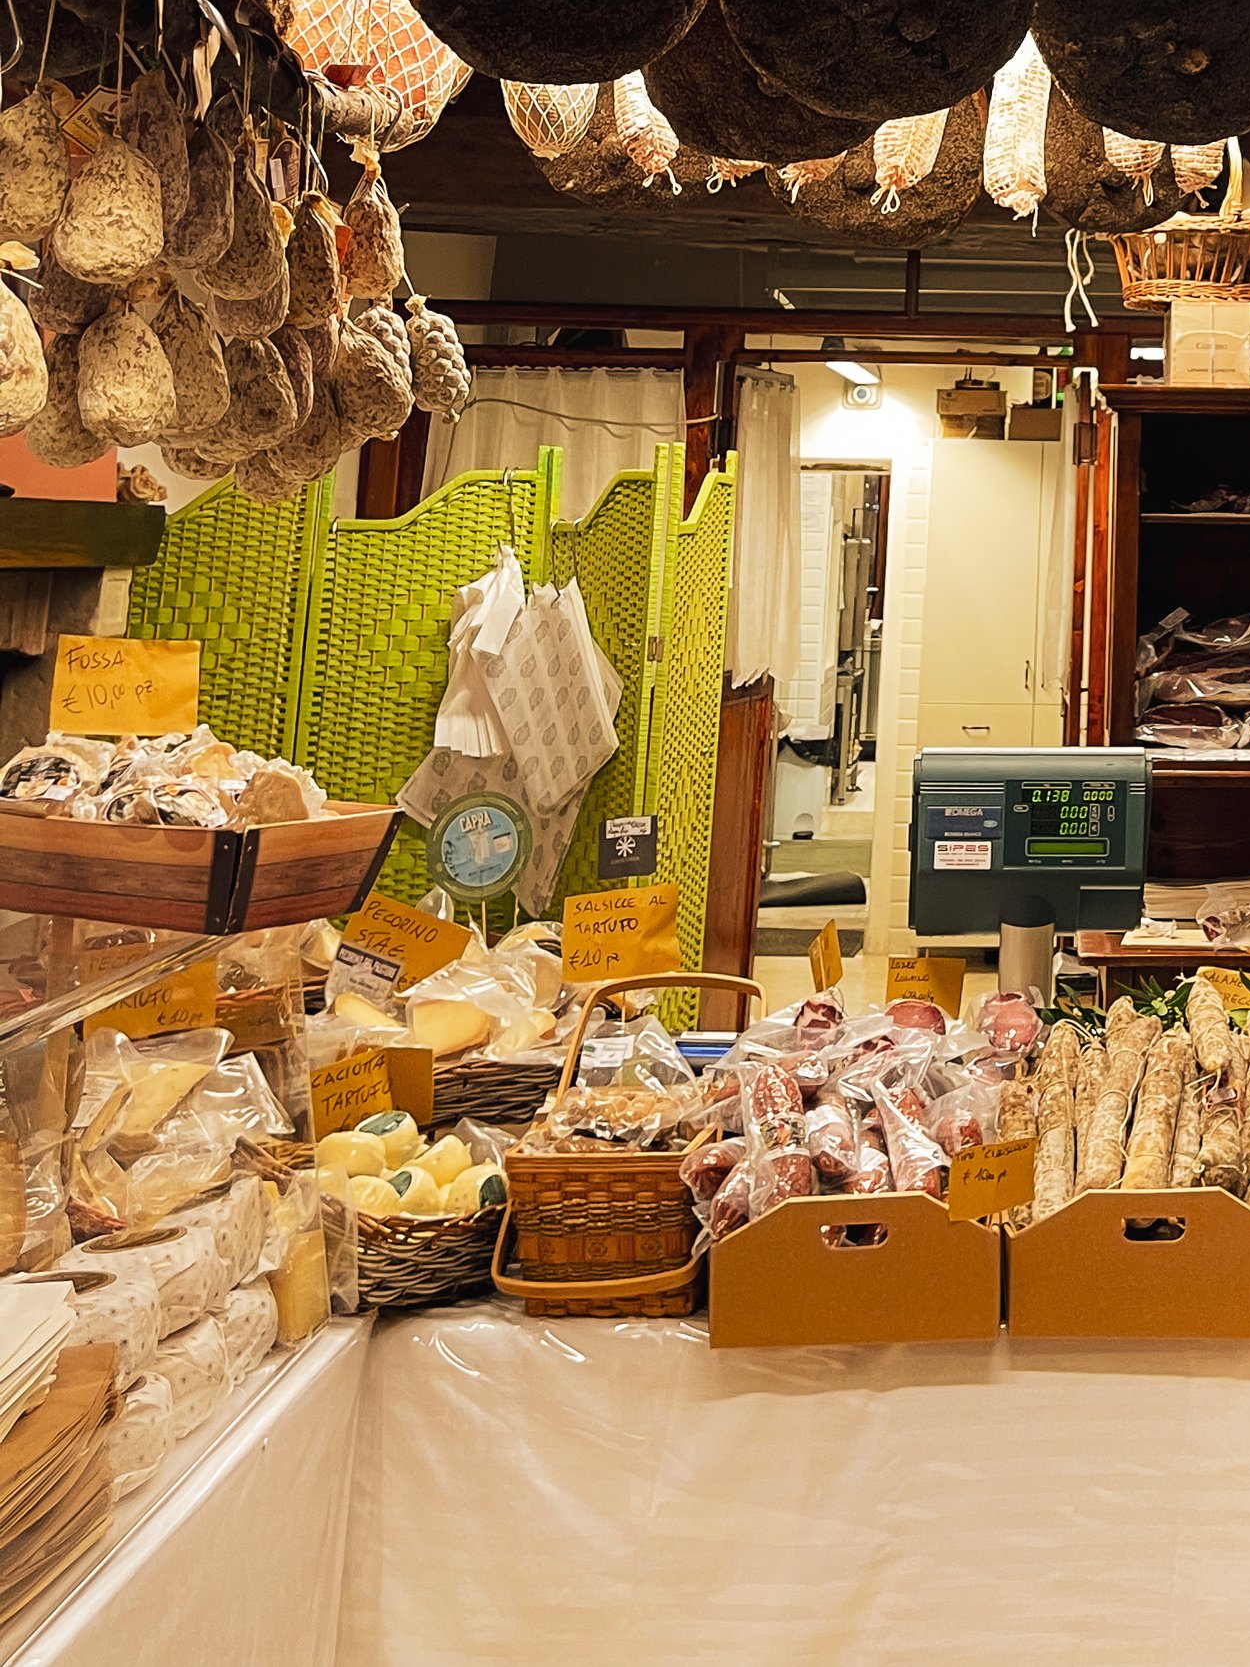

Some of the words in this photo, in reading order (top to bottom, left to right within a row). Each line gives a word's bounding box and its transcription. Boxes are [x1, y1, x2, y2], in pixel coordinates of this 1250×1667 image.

[66, 644, 125, 673] FOSSA
[459, 810, 494, 834] CAPRA
[649, 895, 668, 907] AL
[364, 900, 440, 943] PECORINO
[574, 916, 639, 935] TARTUFO
[311, 1054, 386, 1089] CACIOTTA
